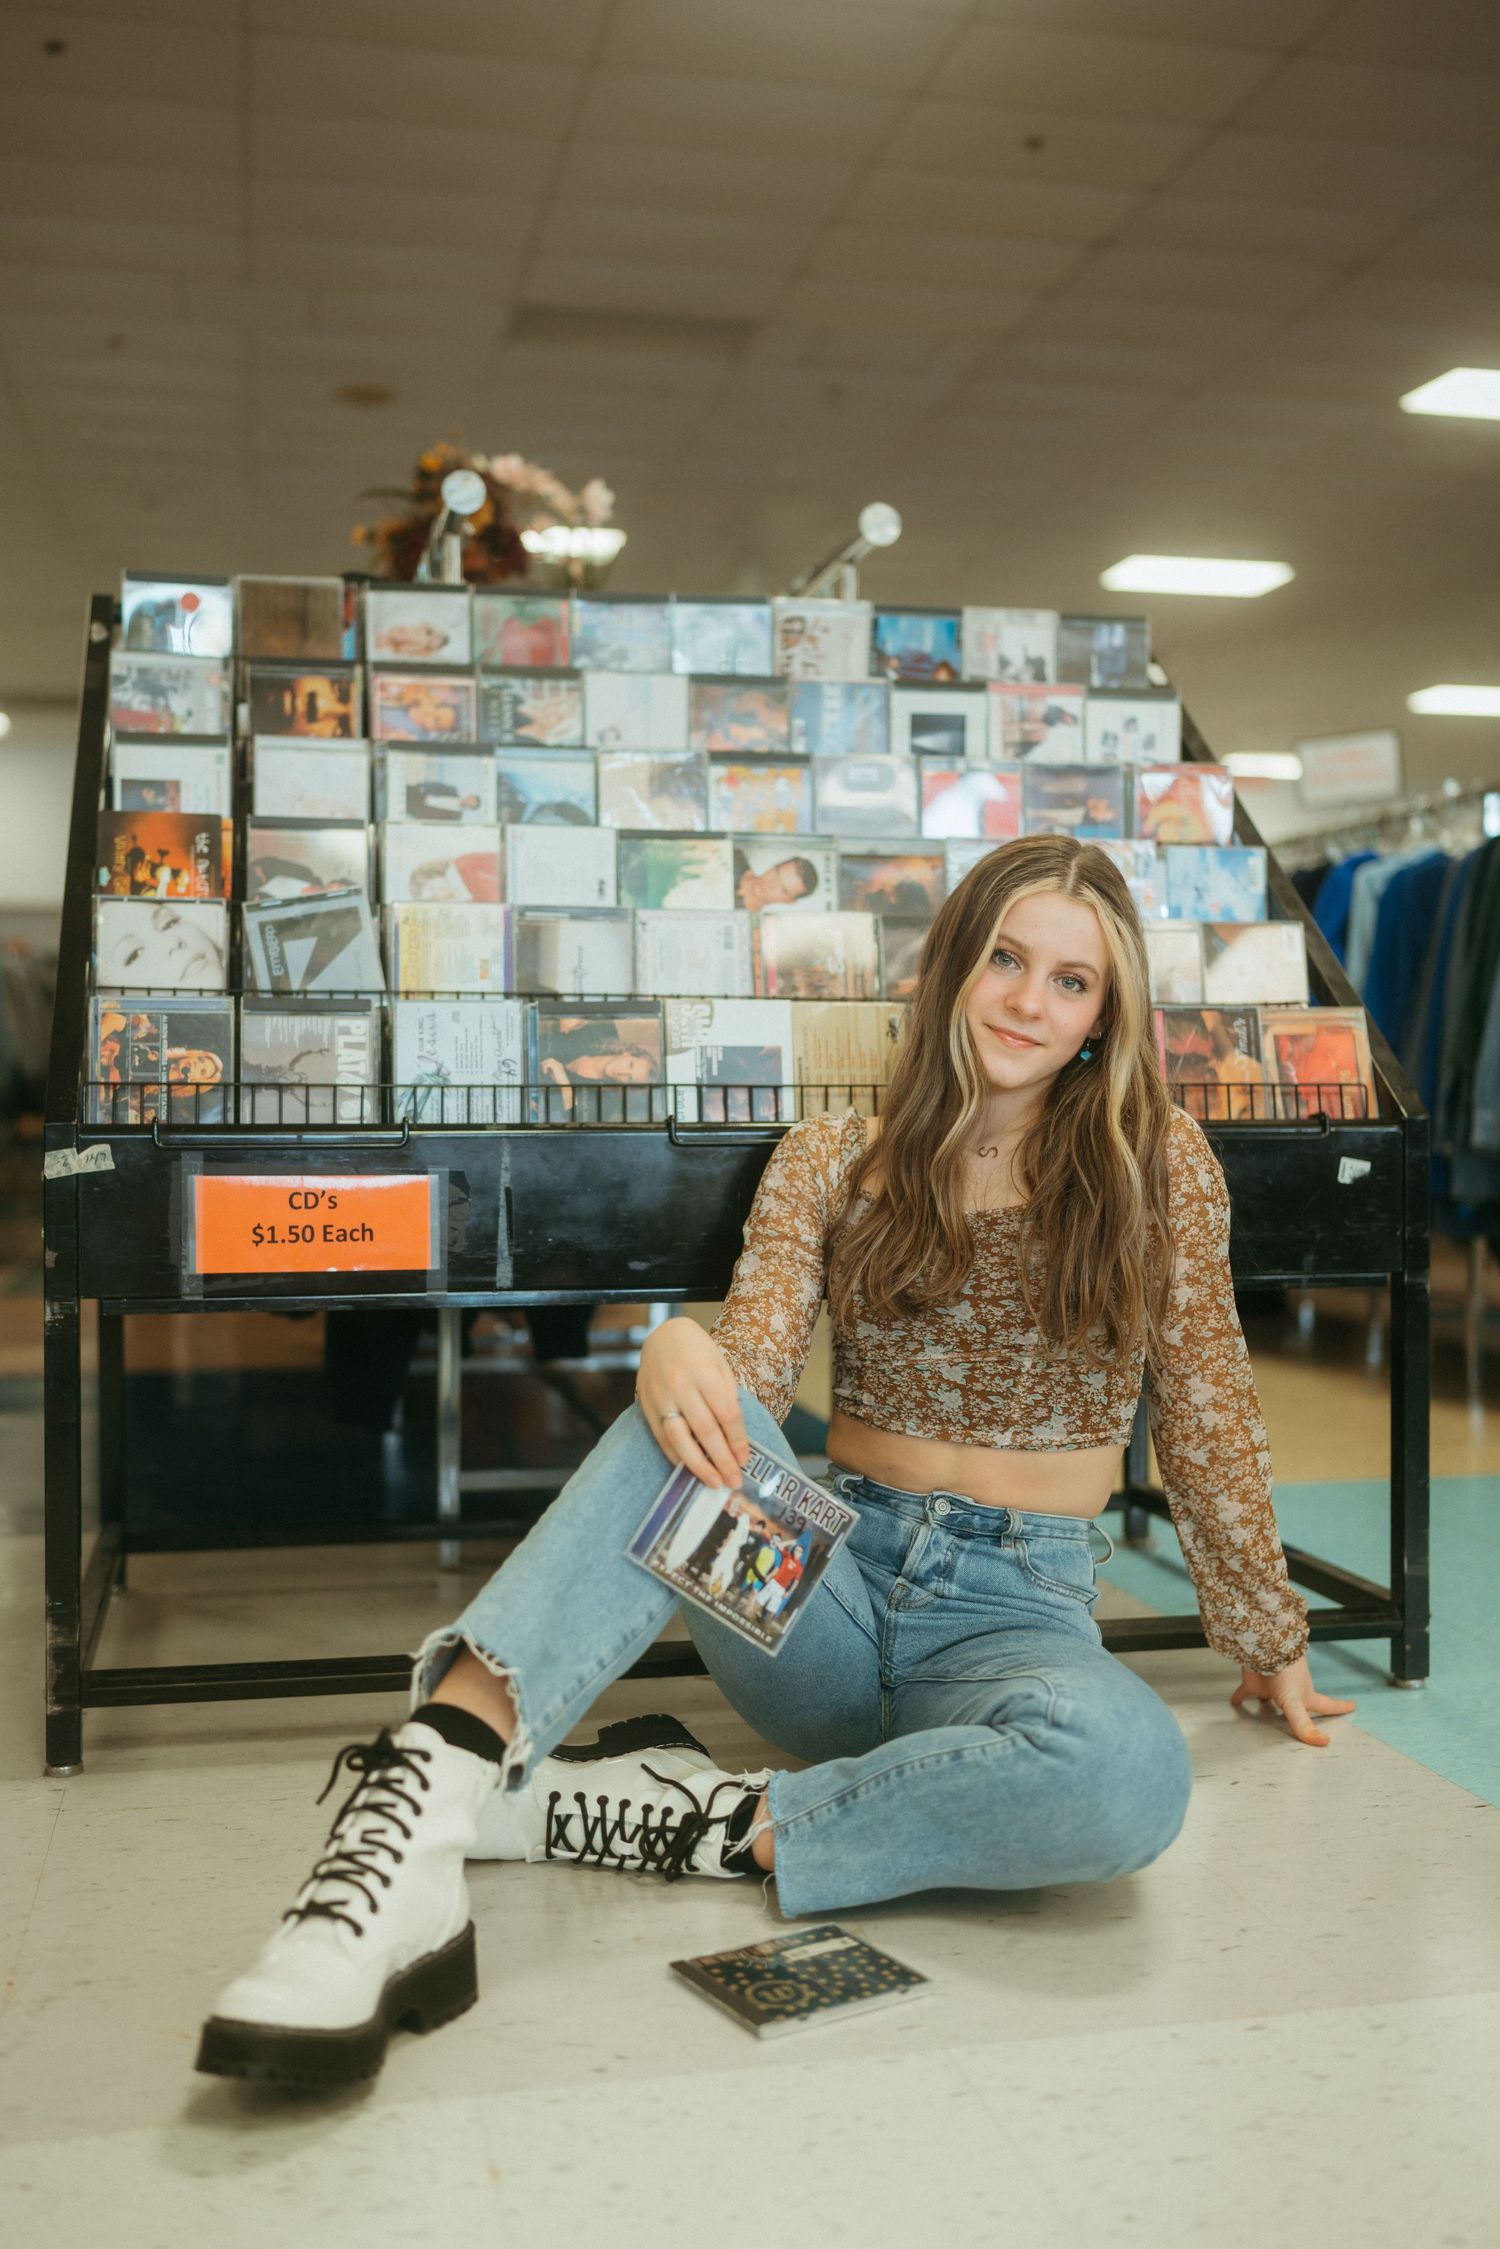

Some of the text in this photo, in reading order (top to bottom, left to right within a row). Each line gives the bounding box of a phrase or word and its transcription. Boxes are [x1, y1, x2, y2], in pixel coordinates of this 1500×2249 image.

[288, 1189, 338, 1210] CD's
[251, 1222, 374, 1247] $1.50 Each
[795, 1487, 851, 1537] KART
[693, 1587, 713, 1602] THE
[714, 1600, 773, 1643] IMPOSSIBLE
